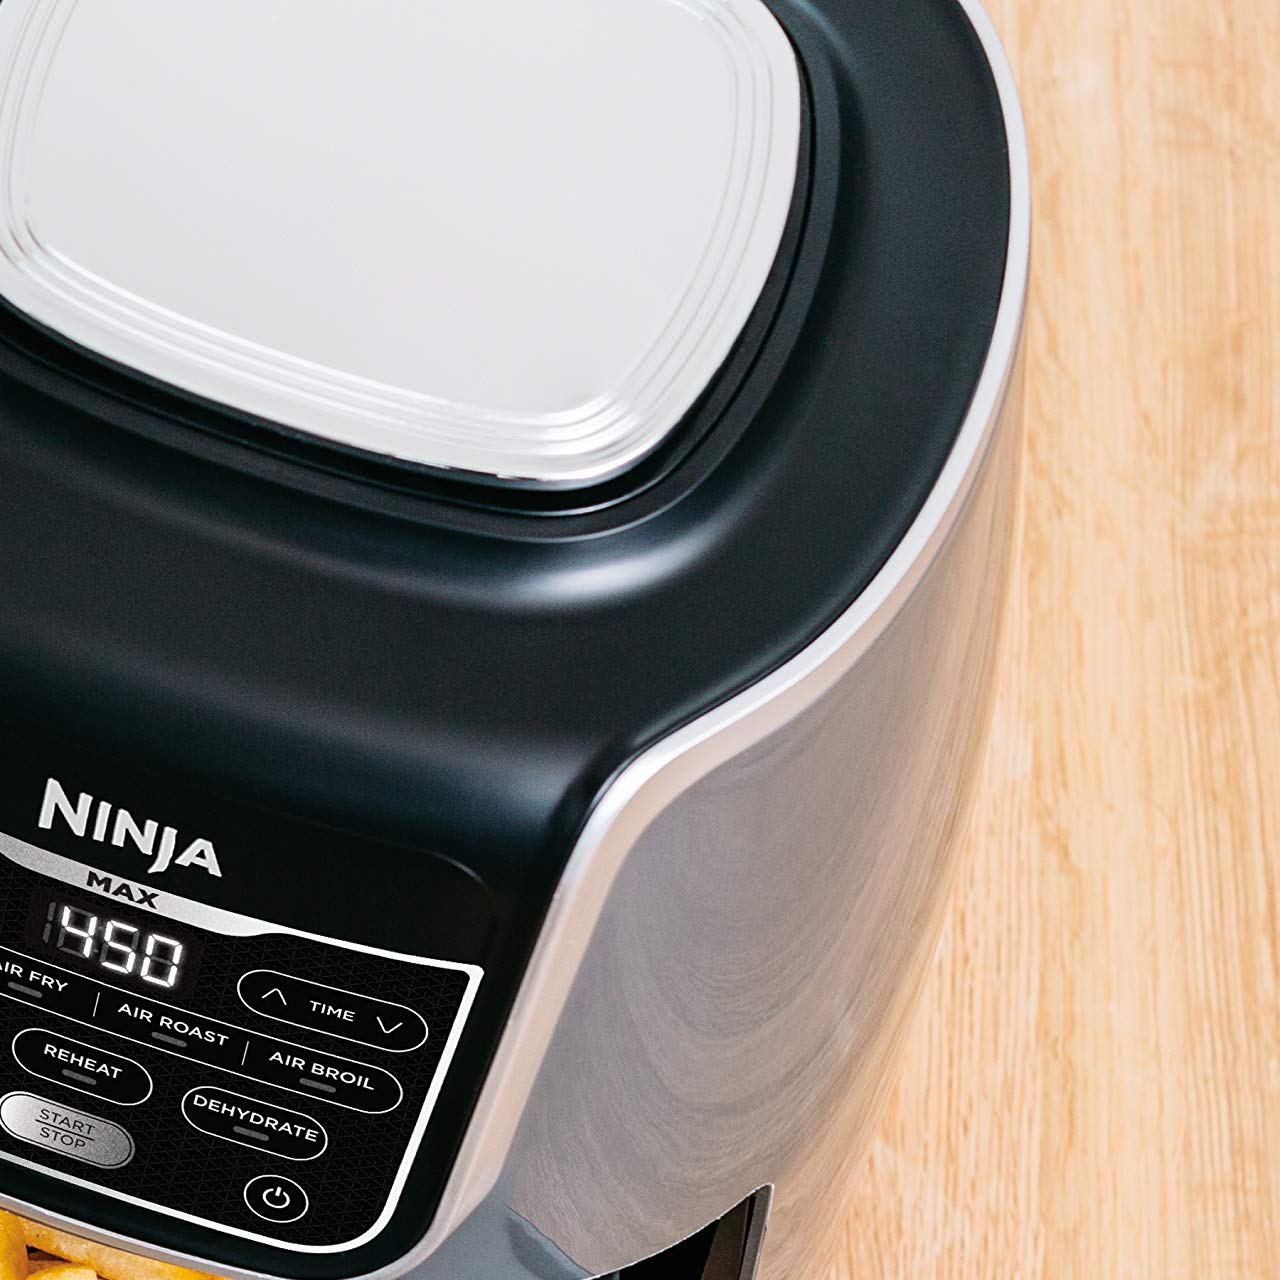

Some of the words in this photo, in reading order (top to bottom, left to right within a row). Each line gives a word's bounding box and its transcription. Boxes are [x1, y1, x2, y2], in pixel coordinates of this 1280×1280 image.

[38, 777, 223, 878] NINJA
[86, 870, 160, 910] MAX
[61, 905, 184, 988] 450
[29, 970, 69, 992] FRY
[117, 1003, 154, 1024] AIR
[159, 1015, 229, 1046] ROAST
[309, 1000, 356, 1023] TIME
[43, 1043, 123, 1080] REHEAT
[268, 1051, 306, 1072] AIR
[311, 1062, 375, 1091] BROIL
[39, 1108, 96, 1135] START
[39, 1126, 87, 1149] STOP
[193, 1094, 320, 1142] DEHYDRATE
